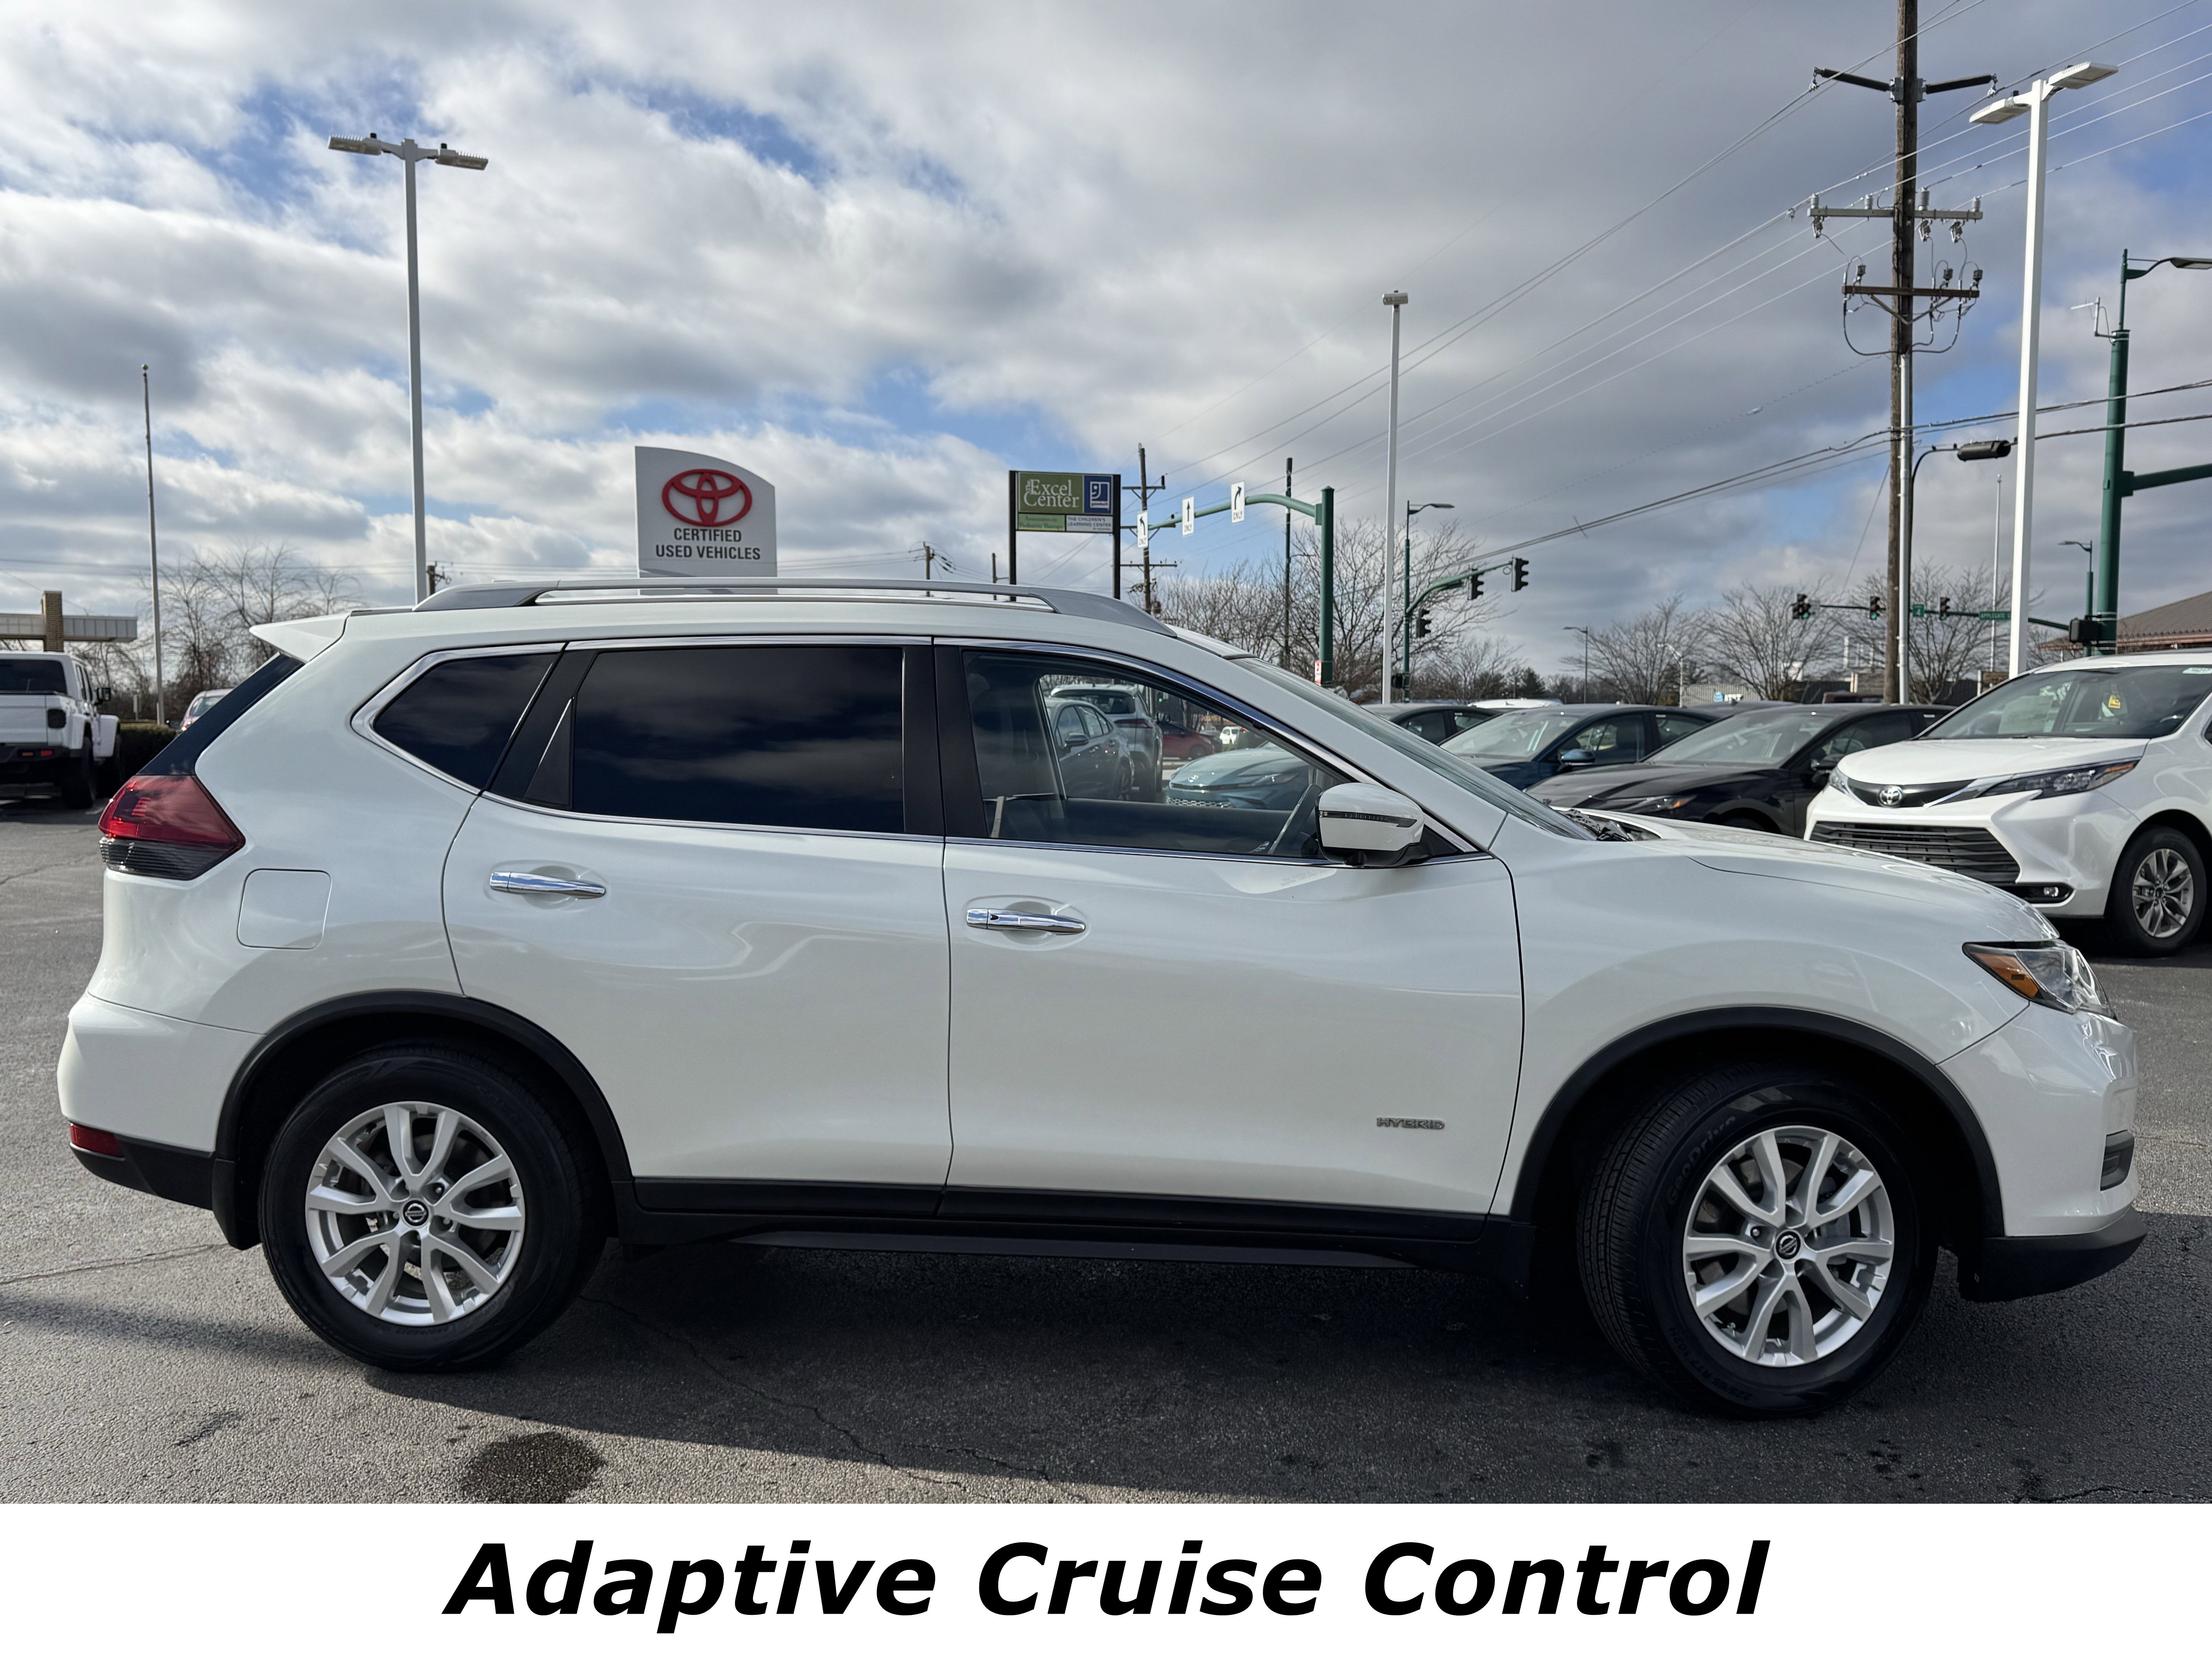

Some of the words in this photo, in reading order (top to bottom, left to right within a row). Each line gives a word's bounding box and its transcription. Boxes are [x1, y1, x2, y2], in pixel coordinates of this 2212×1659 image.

[1030, 479, 1072, 496] Excel
[1024, 491, 1080, 508] Center
[673, 527, 742, 543] CERTIFIED
[655, 544, 692, 558] USED
[697, 546, 761, 560] VEHICLES
[1376, 1117, 1445, 1130] HYBRID
